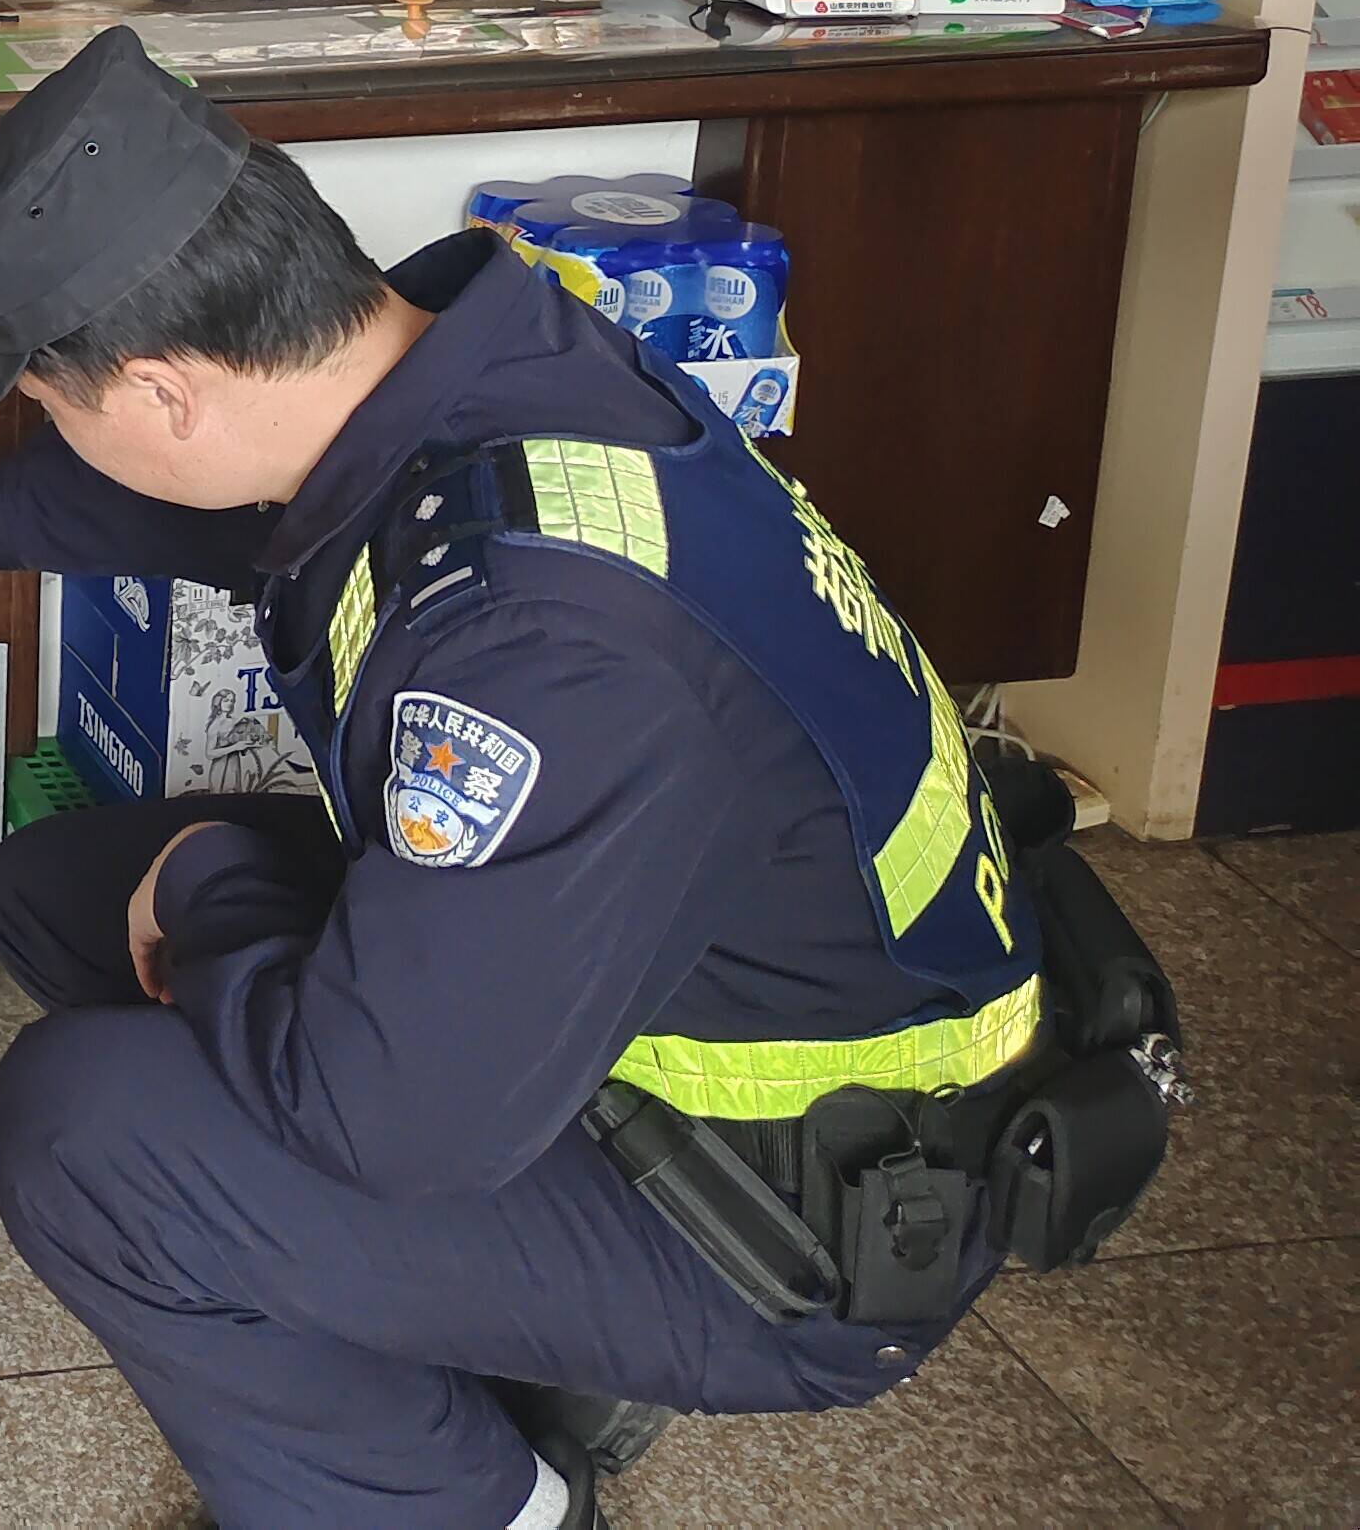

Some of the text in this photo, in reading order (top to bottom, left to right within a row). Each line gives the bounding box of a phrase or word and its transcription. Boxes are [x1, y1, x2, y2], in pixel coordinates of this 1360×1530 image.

[77, 691, 144, 798] TSINGTAO
[401, 702, 526, 776] 中华人民共和国
[410, 774, 463, 808] POLICE
